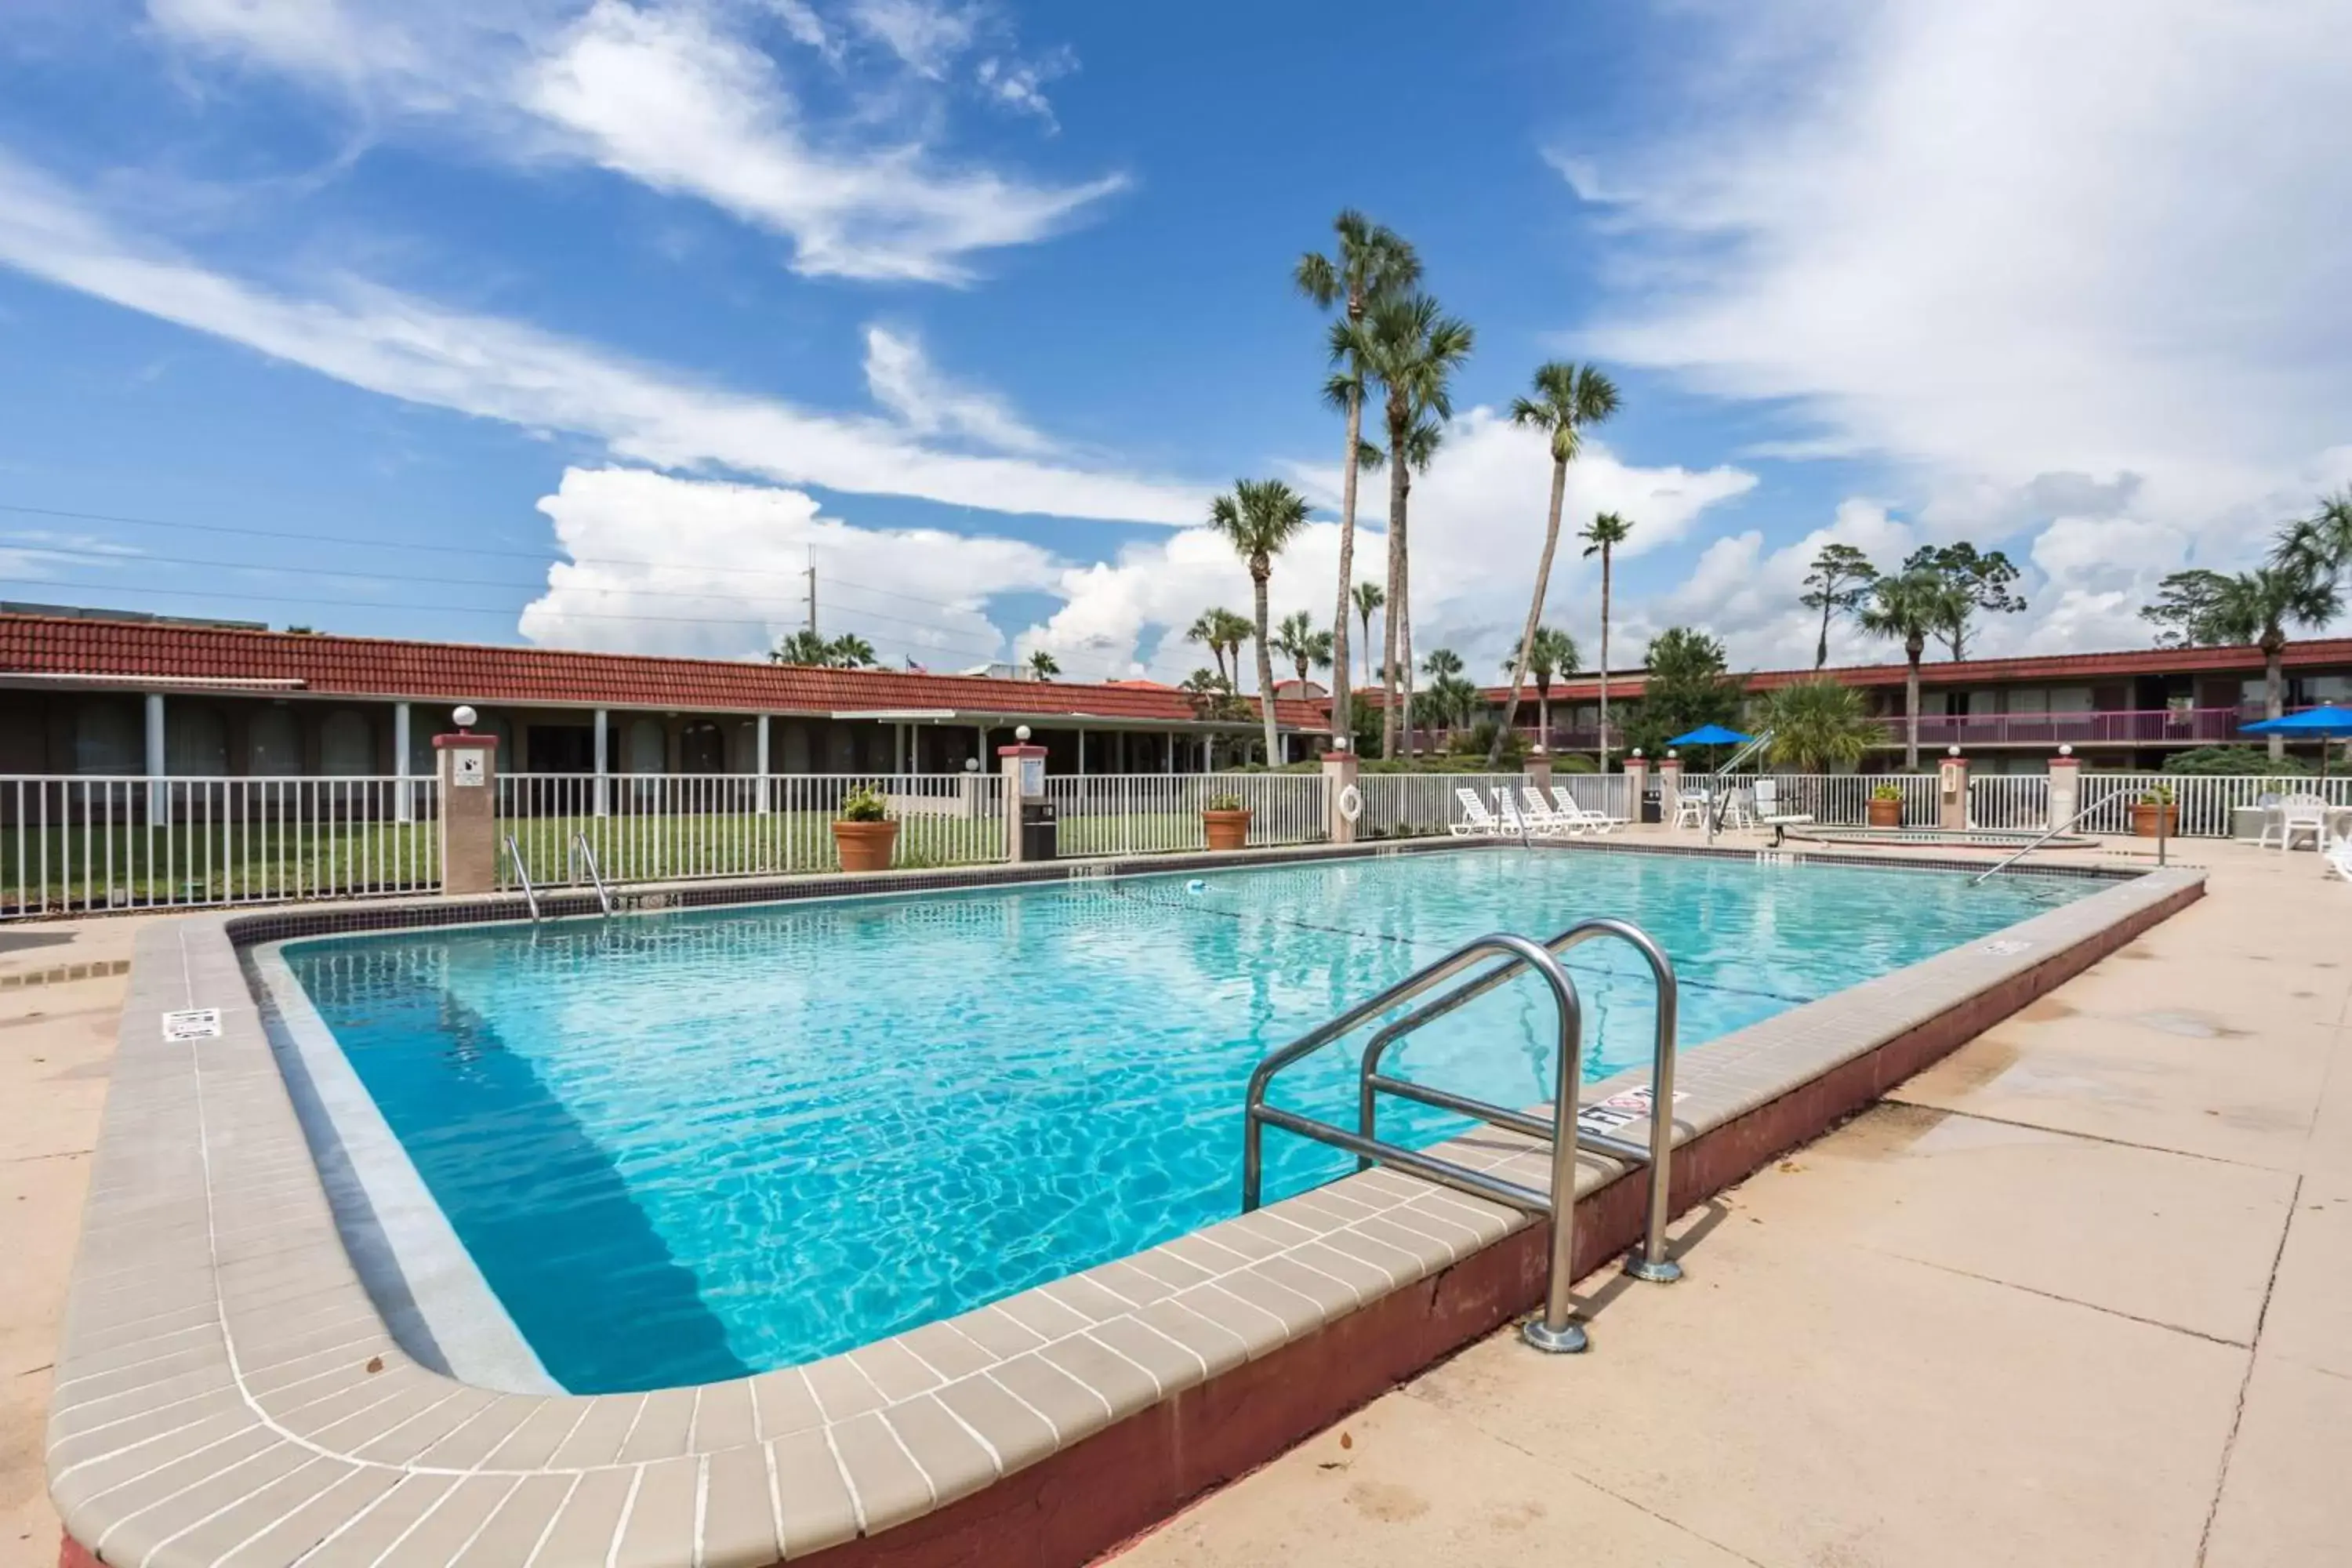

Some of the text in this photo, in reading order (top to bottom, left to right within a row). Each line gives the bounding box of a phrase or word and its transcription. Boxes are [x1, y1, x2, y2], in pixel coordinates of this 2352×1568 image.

[612, 894, 678, 909] 8 FT 24
